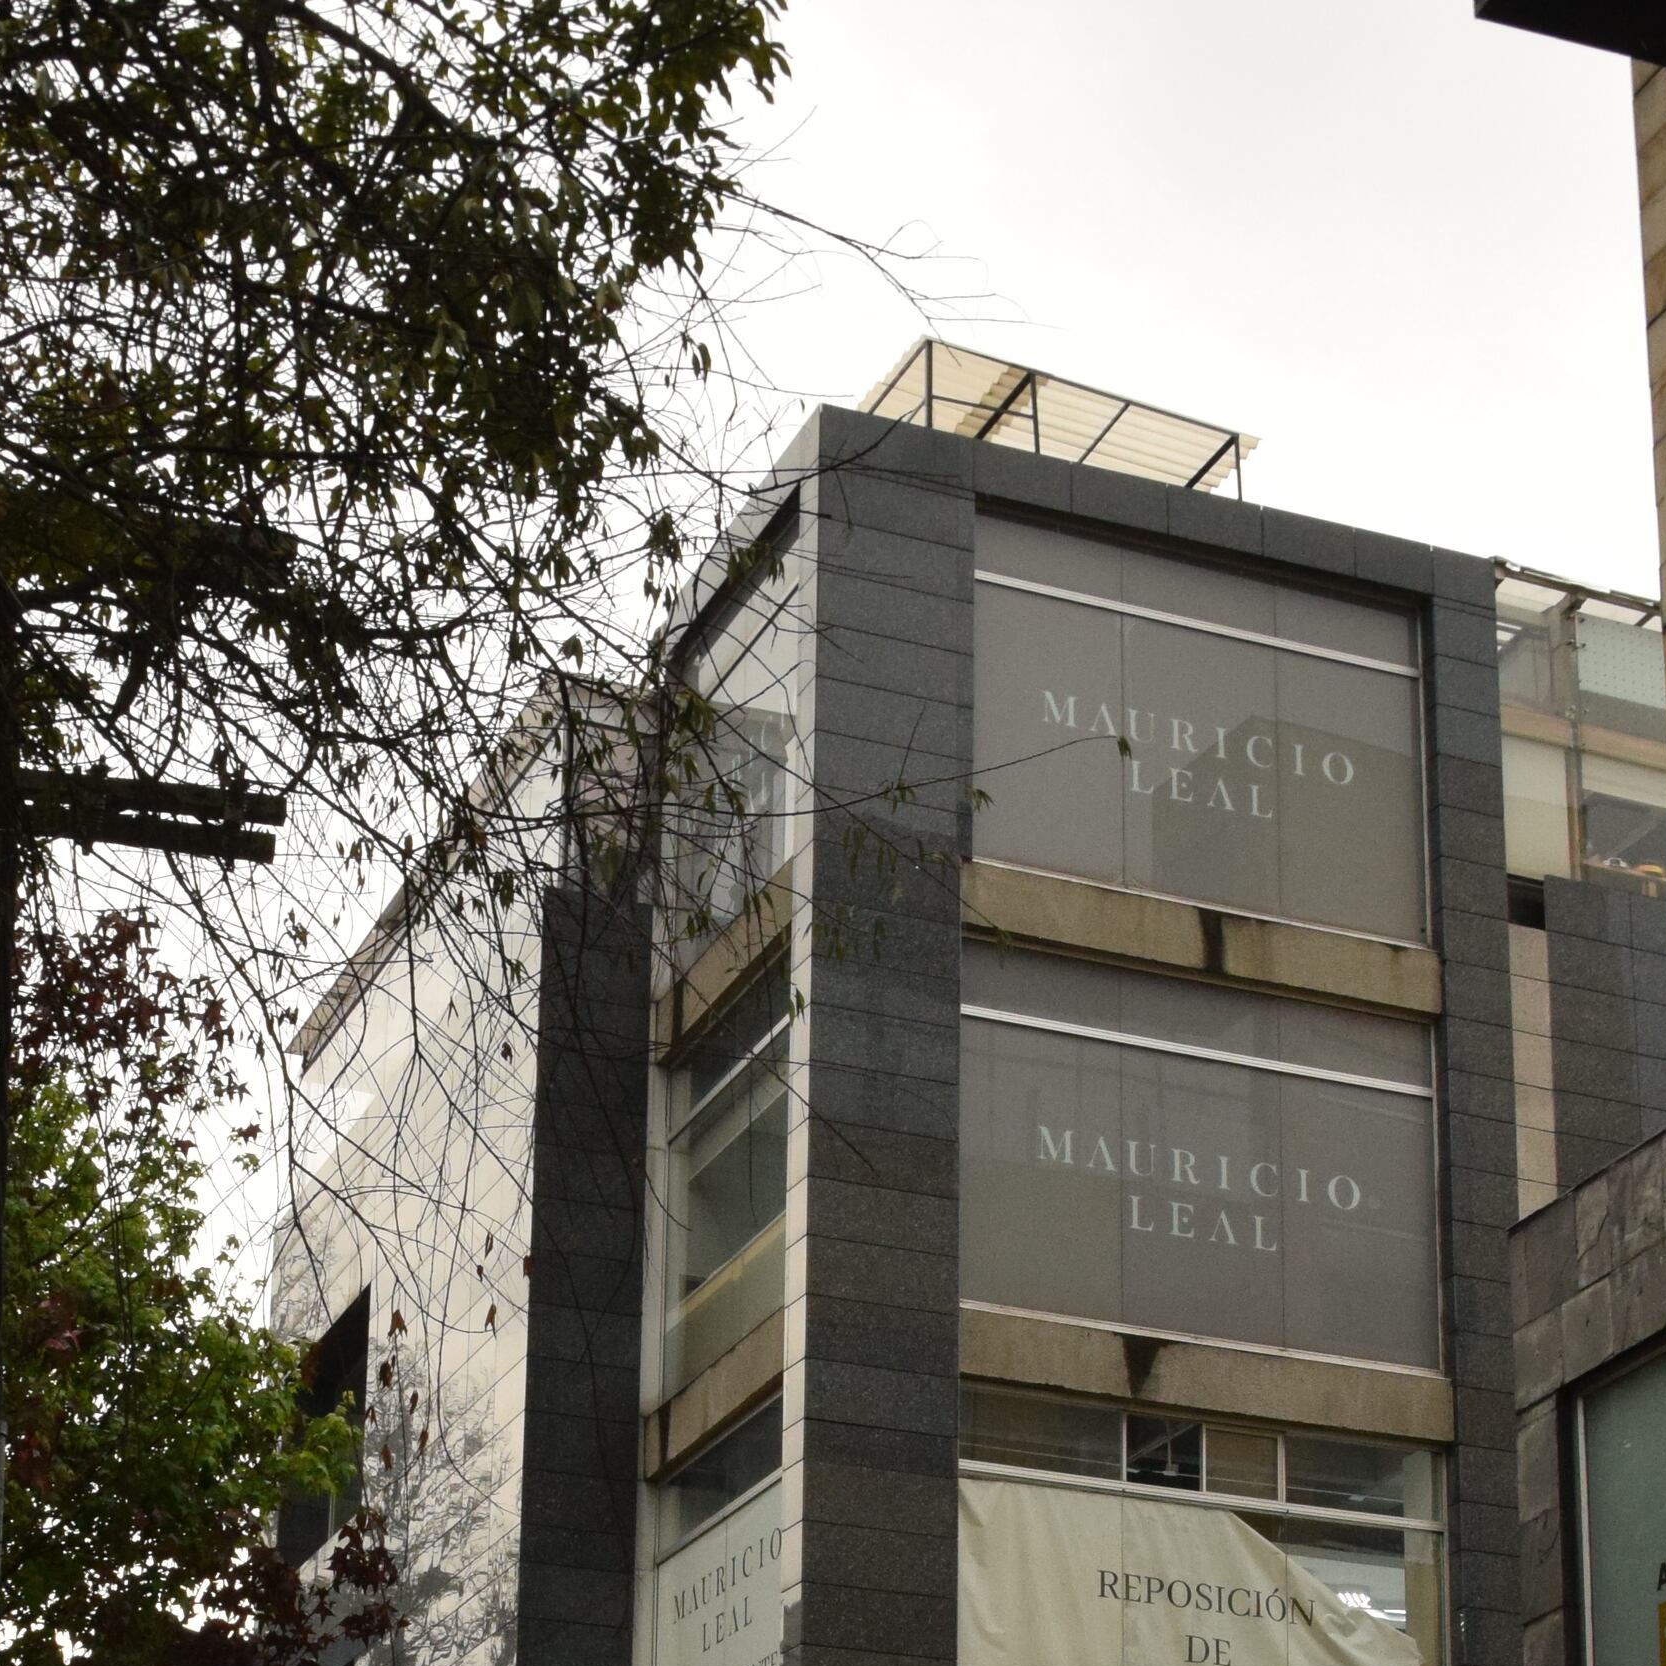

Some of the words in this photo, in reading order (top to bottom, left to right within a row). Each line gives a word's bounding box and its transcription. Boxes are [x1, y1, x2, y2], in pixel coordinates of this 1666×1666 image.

[1042, 690, 1355, 786] MAURICIO
[1129, 760, 1274, 819] LEAL
[1038, 1126, 1361, 1211] MAURICIO
[1128, 1195, 1278, 1252] LEAL
[673, 1527, 782, 1624] MAURICIO
[1097, 1568, 1316, 1627] REPOSICIÓN
[702, 1596, 753, 1653] LEAL
